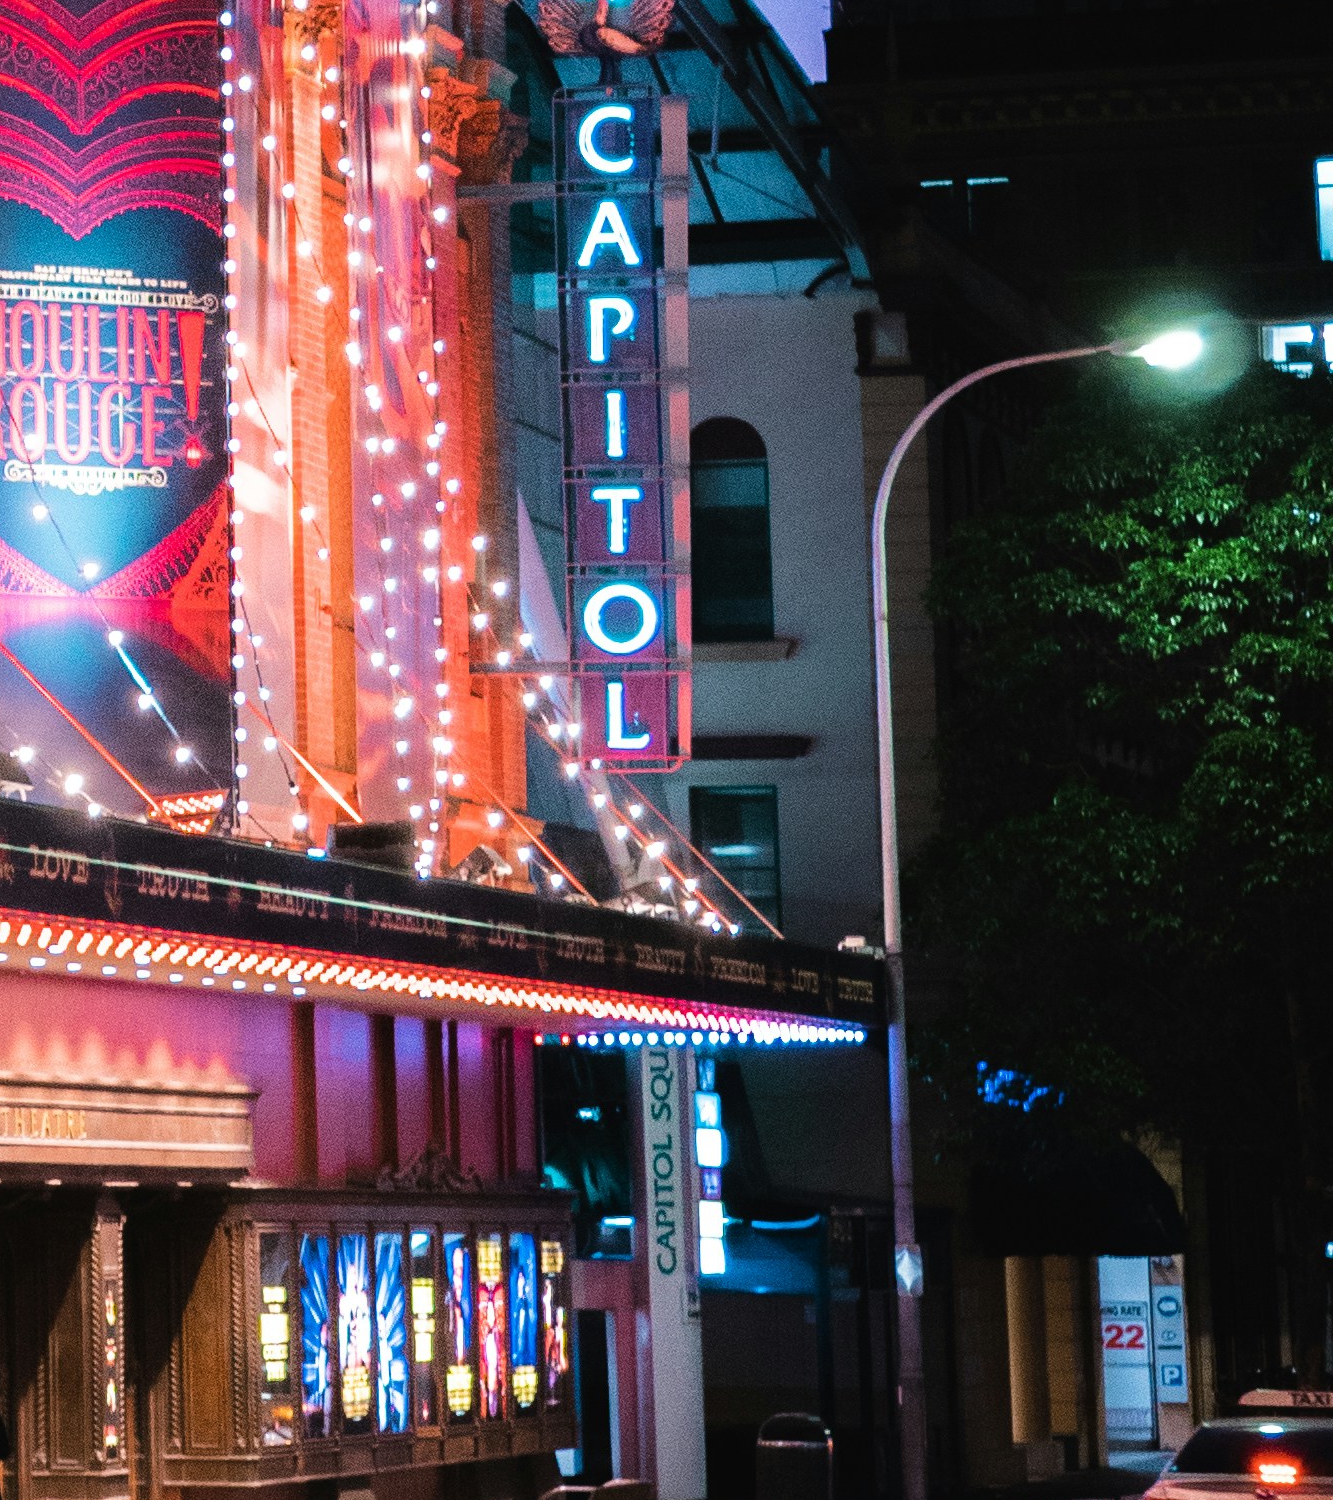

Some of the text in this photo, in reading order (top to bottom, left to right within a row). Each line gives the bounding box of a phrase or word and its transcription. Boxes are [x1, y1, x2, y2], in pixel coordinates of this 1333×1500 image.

[577, 103, 659, 752] CAPITOL
[29, 844, 90, 884] LOVE
[136, 864, 211, 903] TRUTH
[0, 1106, 89, 1140] THEATRE
[649, 1045, 678, 1276] CAPITOL SQU
[1104, 1323, 1145, 1349] 22
[1291, 1391, 1331, 1407] TAXI
